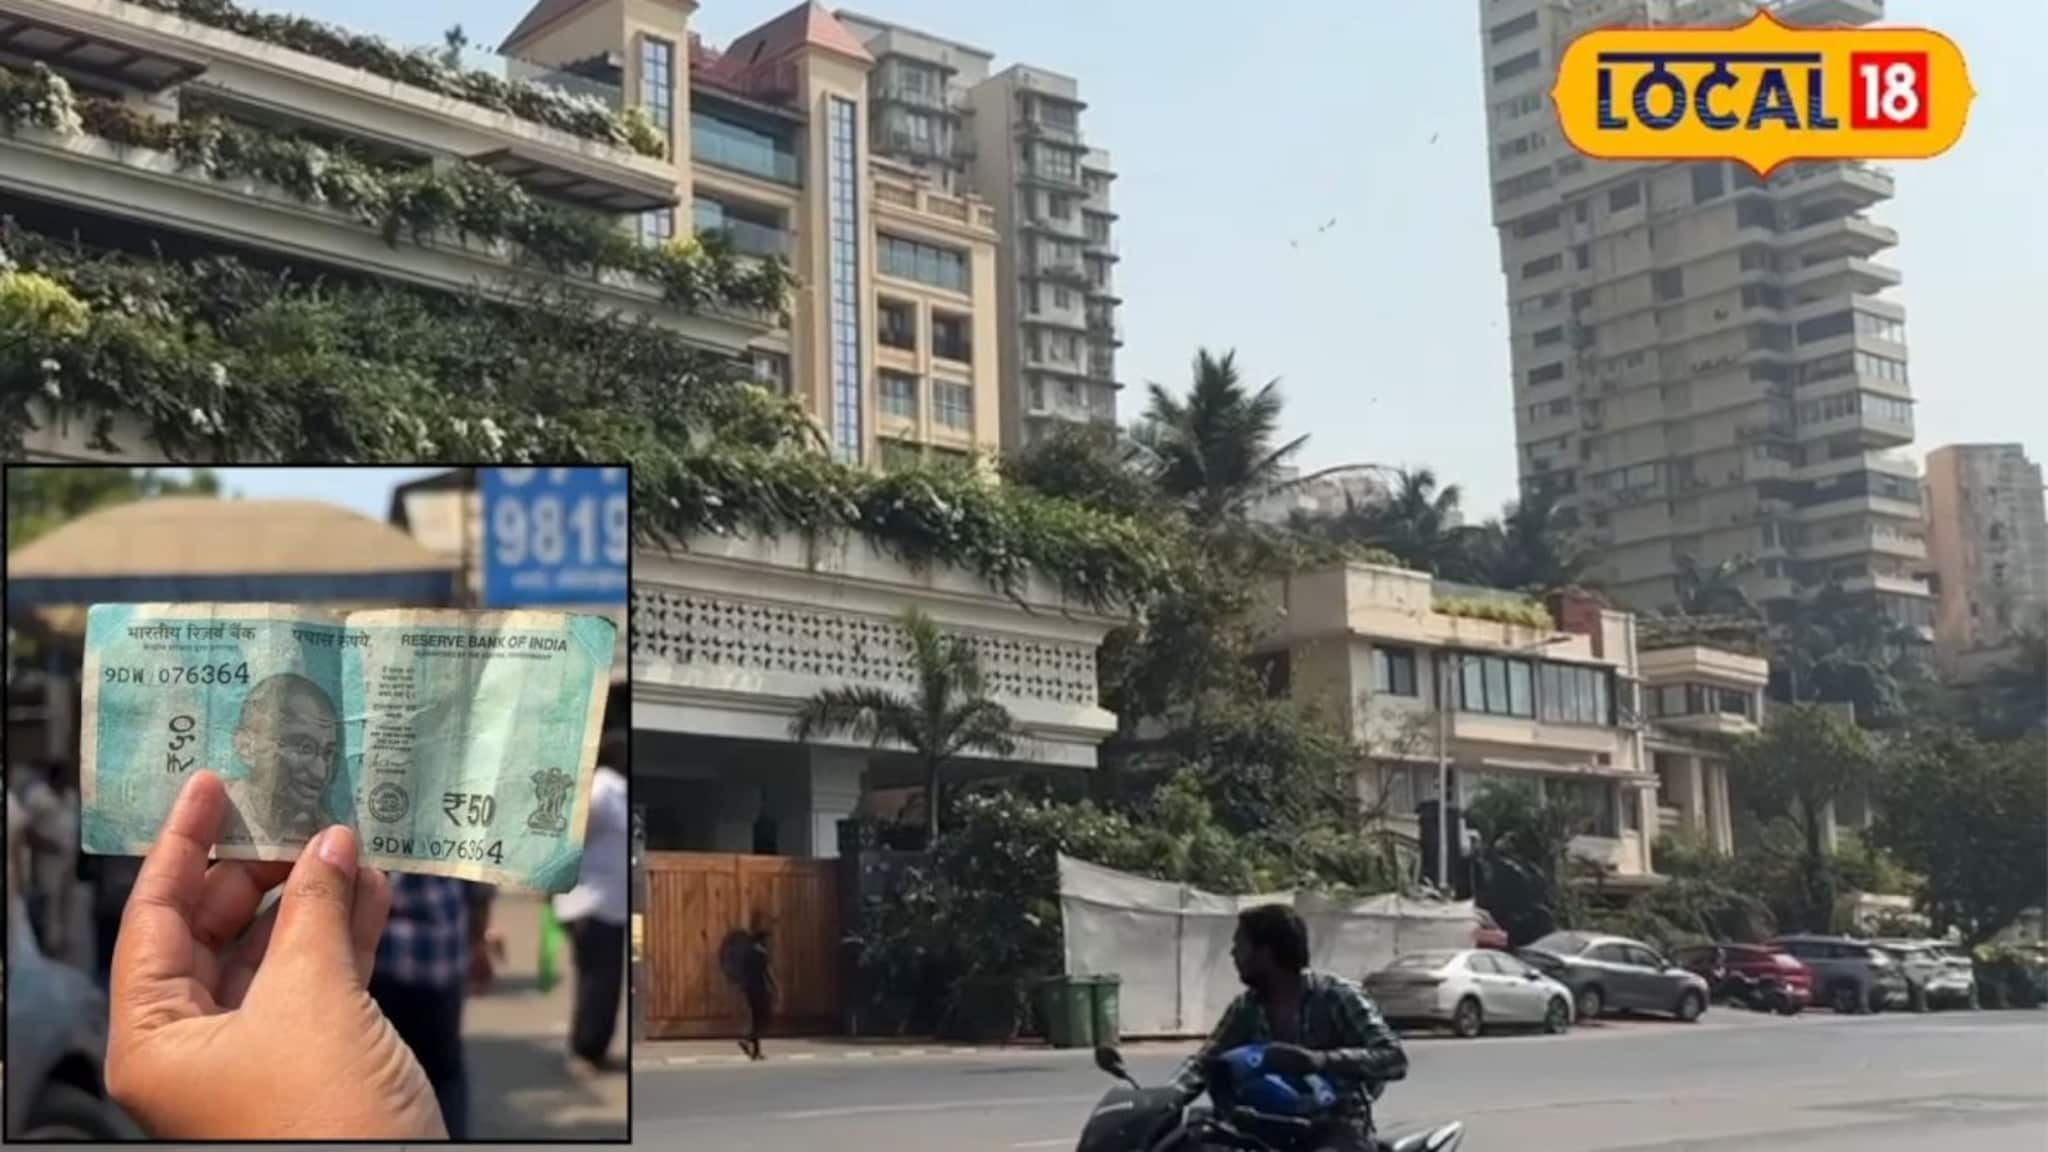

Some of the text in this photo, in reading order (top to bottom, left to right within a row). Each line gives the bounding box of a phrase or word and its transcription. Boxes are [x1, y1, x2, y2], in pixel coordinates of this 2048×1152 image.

[494, 496, 627, 566] 9819
[128, 622, 180, 640] भारतीय
[401, 633, 567, 651] RESERVE BANK OF INDIA
[104, 661, 250, 685] 9DW 076364
[442, 792, 496, 827] ₹50
[371, 836, 415, 855] 9DW
